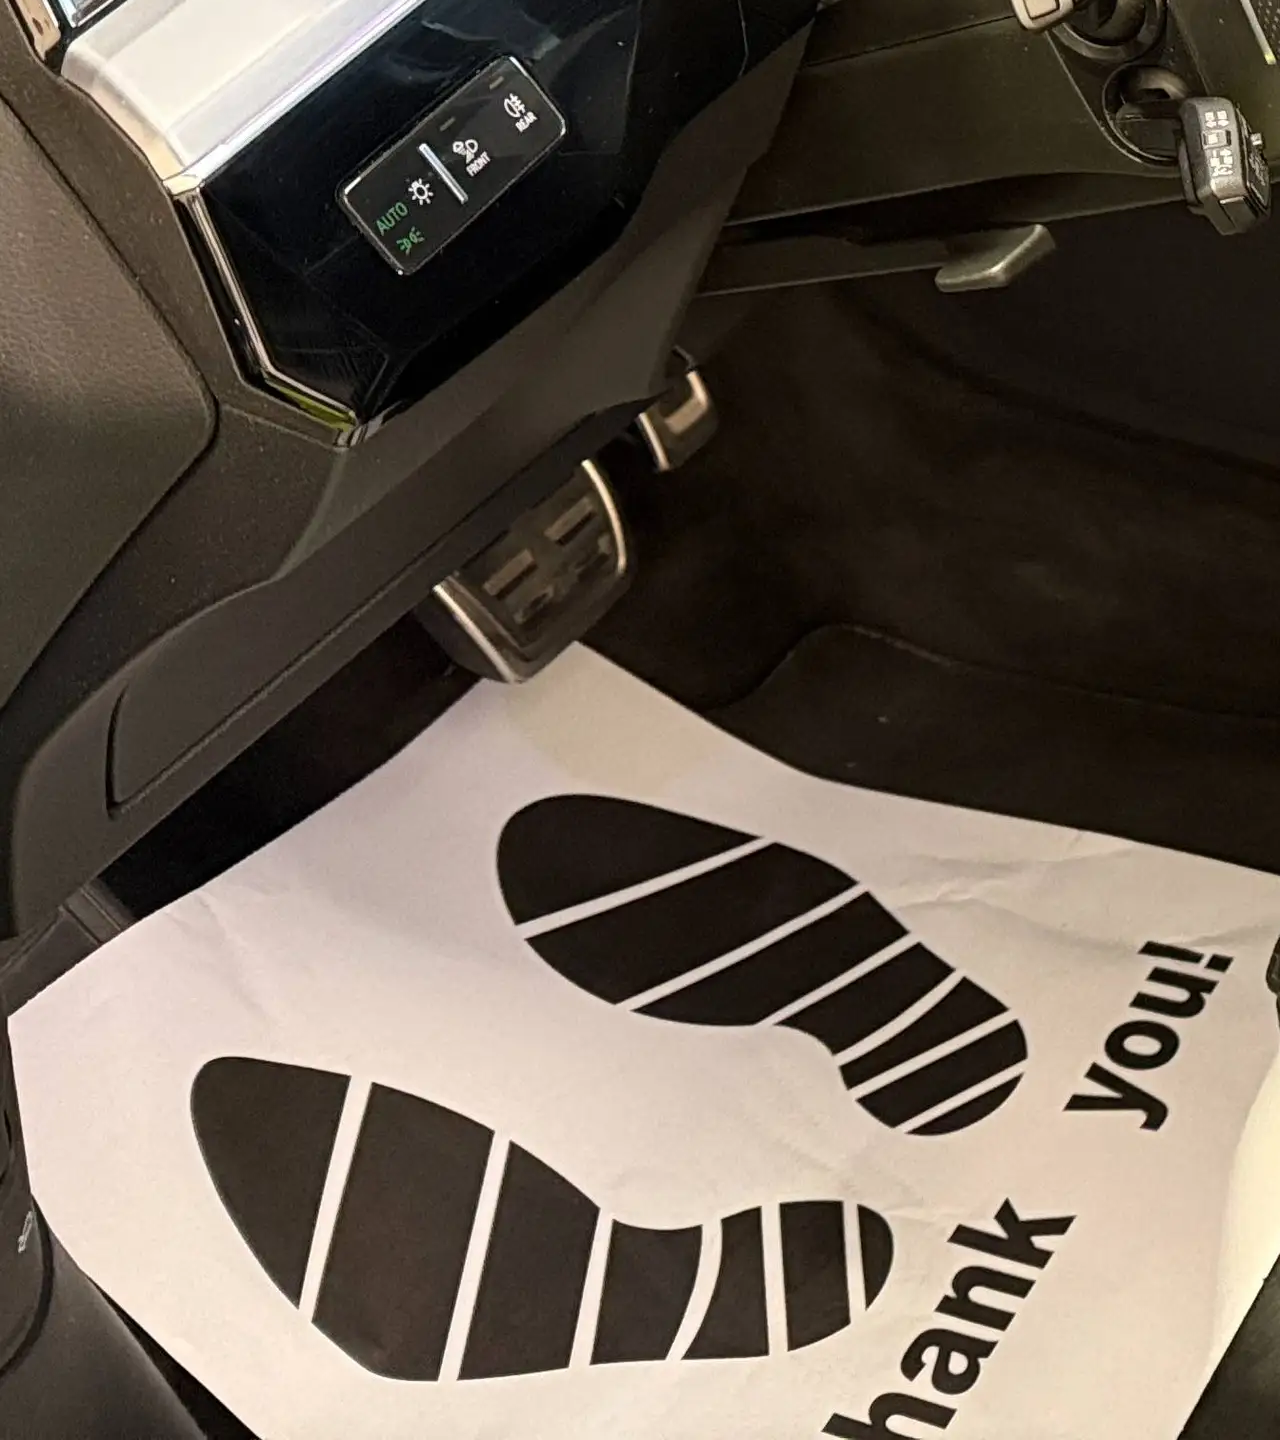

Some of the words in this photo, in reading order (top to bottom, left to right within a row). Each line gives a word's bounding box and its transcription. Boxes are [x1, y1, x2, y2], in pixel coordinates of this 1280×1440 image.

[514, 110, 538, 134] REAR
[465, 150, 491, 178] FRONT
[375, 200, 409, 237] AUTO
[1062, 940, 1234, 1132] you!
